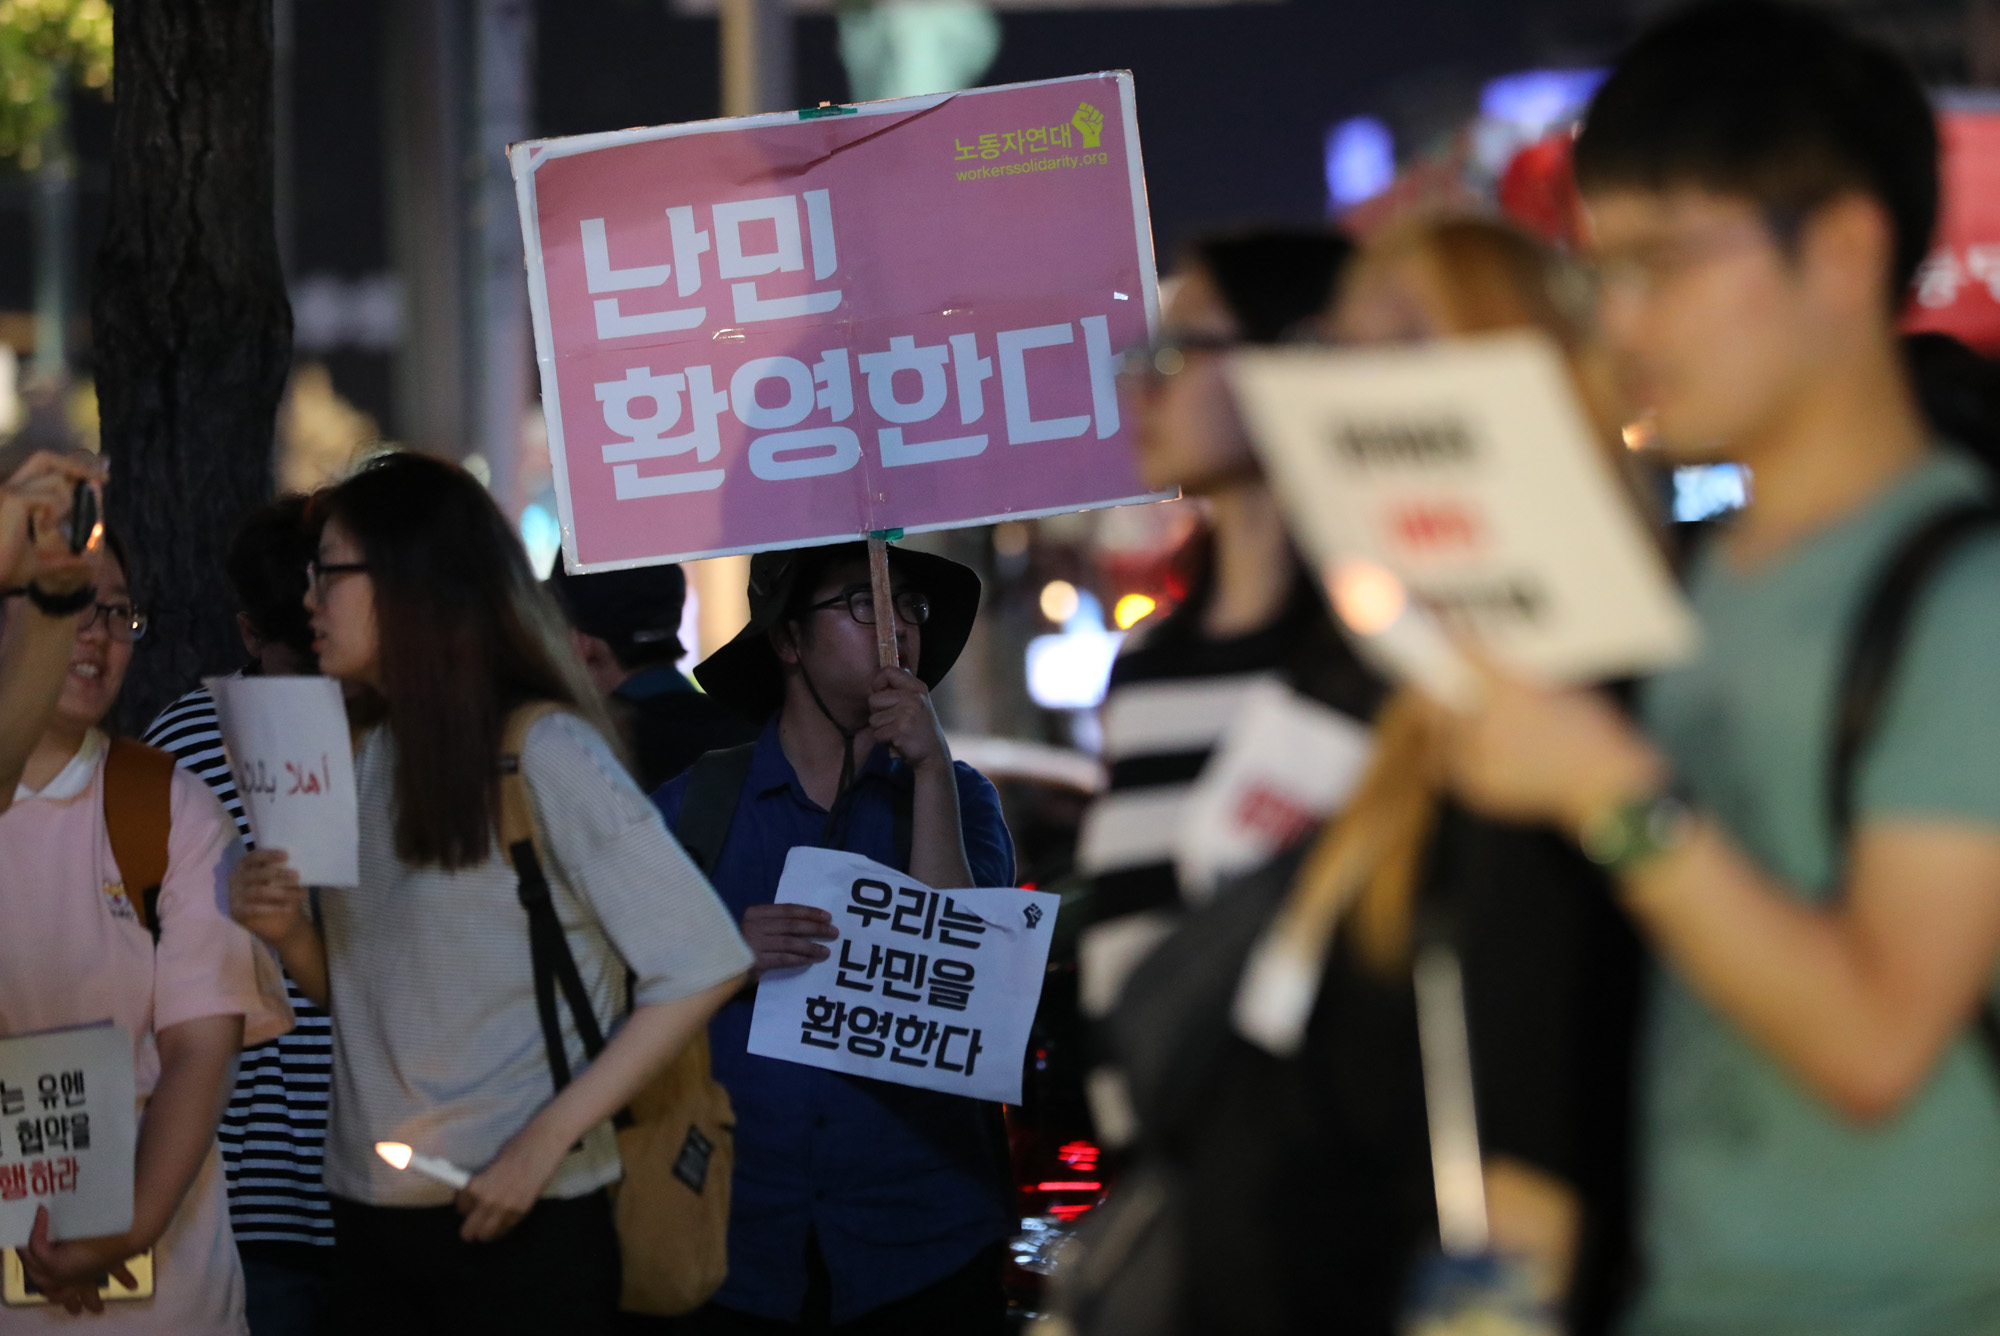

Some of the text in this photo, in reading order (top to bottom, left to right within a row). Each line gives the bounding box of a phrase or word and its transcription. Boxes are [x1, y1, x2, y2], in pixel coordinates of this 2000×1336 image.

[954, 122, 1073, 161] 노동자연대
[955, 152, 1109, 182] workerssolidarity.org
[579, 188, 843, 340] 난민
[594, 314, 1126, 501] 환영한다
[846, 877, 987, 950] 우리는
[835, 938, 976, 1012] 난민을
[800, 995, 984, 1077] 환영한다
[38, 1067, 87, 1111] 유엔
[17, 1112, 91, 1156] 협약을
